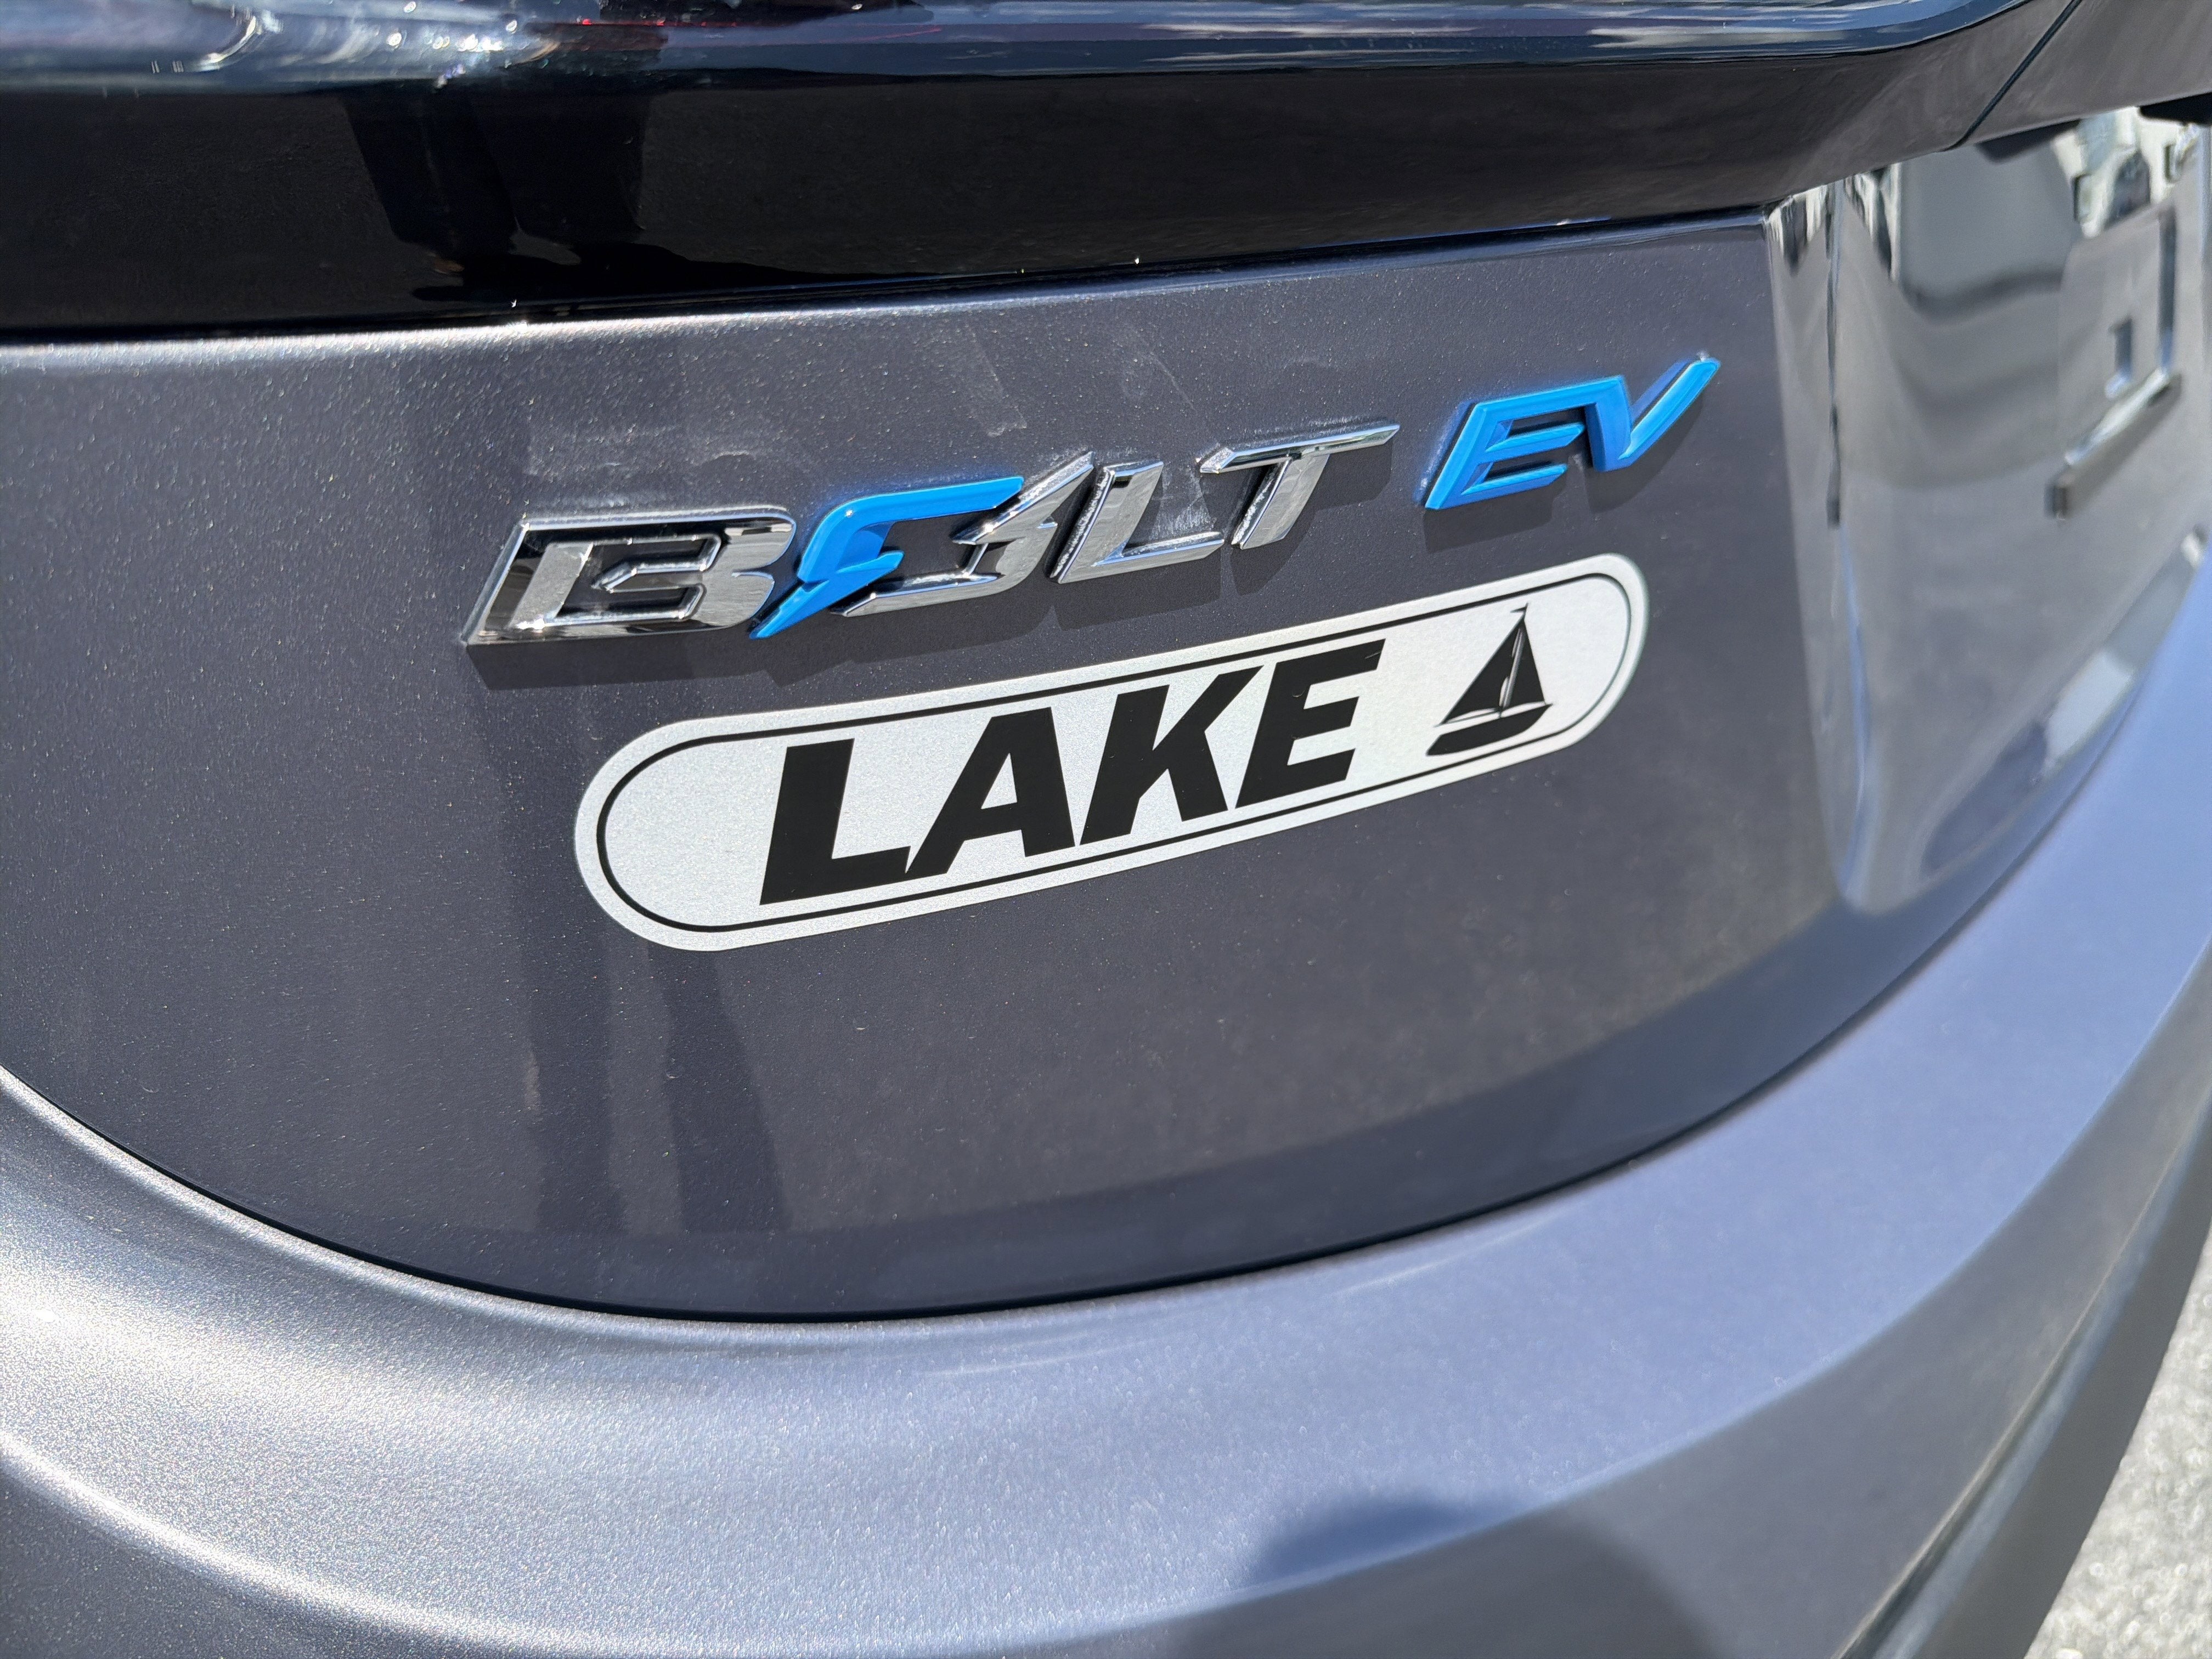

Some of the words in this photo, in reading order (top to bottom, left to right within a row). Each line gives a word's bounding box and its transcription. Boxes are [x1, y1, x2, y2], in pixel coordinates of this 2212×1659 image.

[462, 424, 1400, 645] BOLT
[1422, 354, 1720, 510] EV
[759, 638, 1386, 905] LAKE
